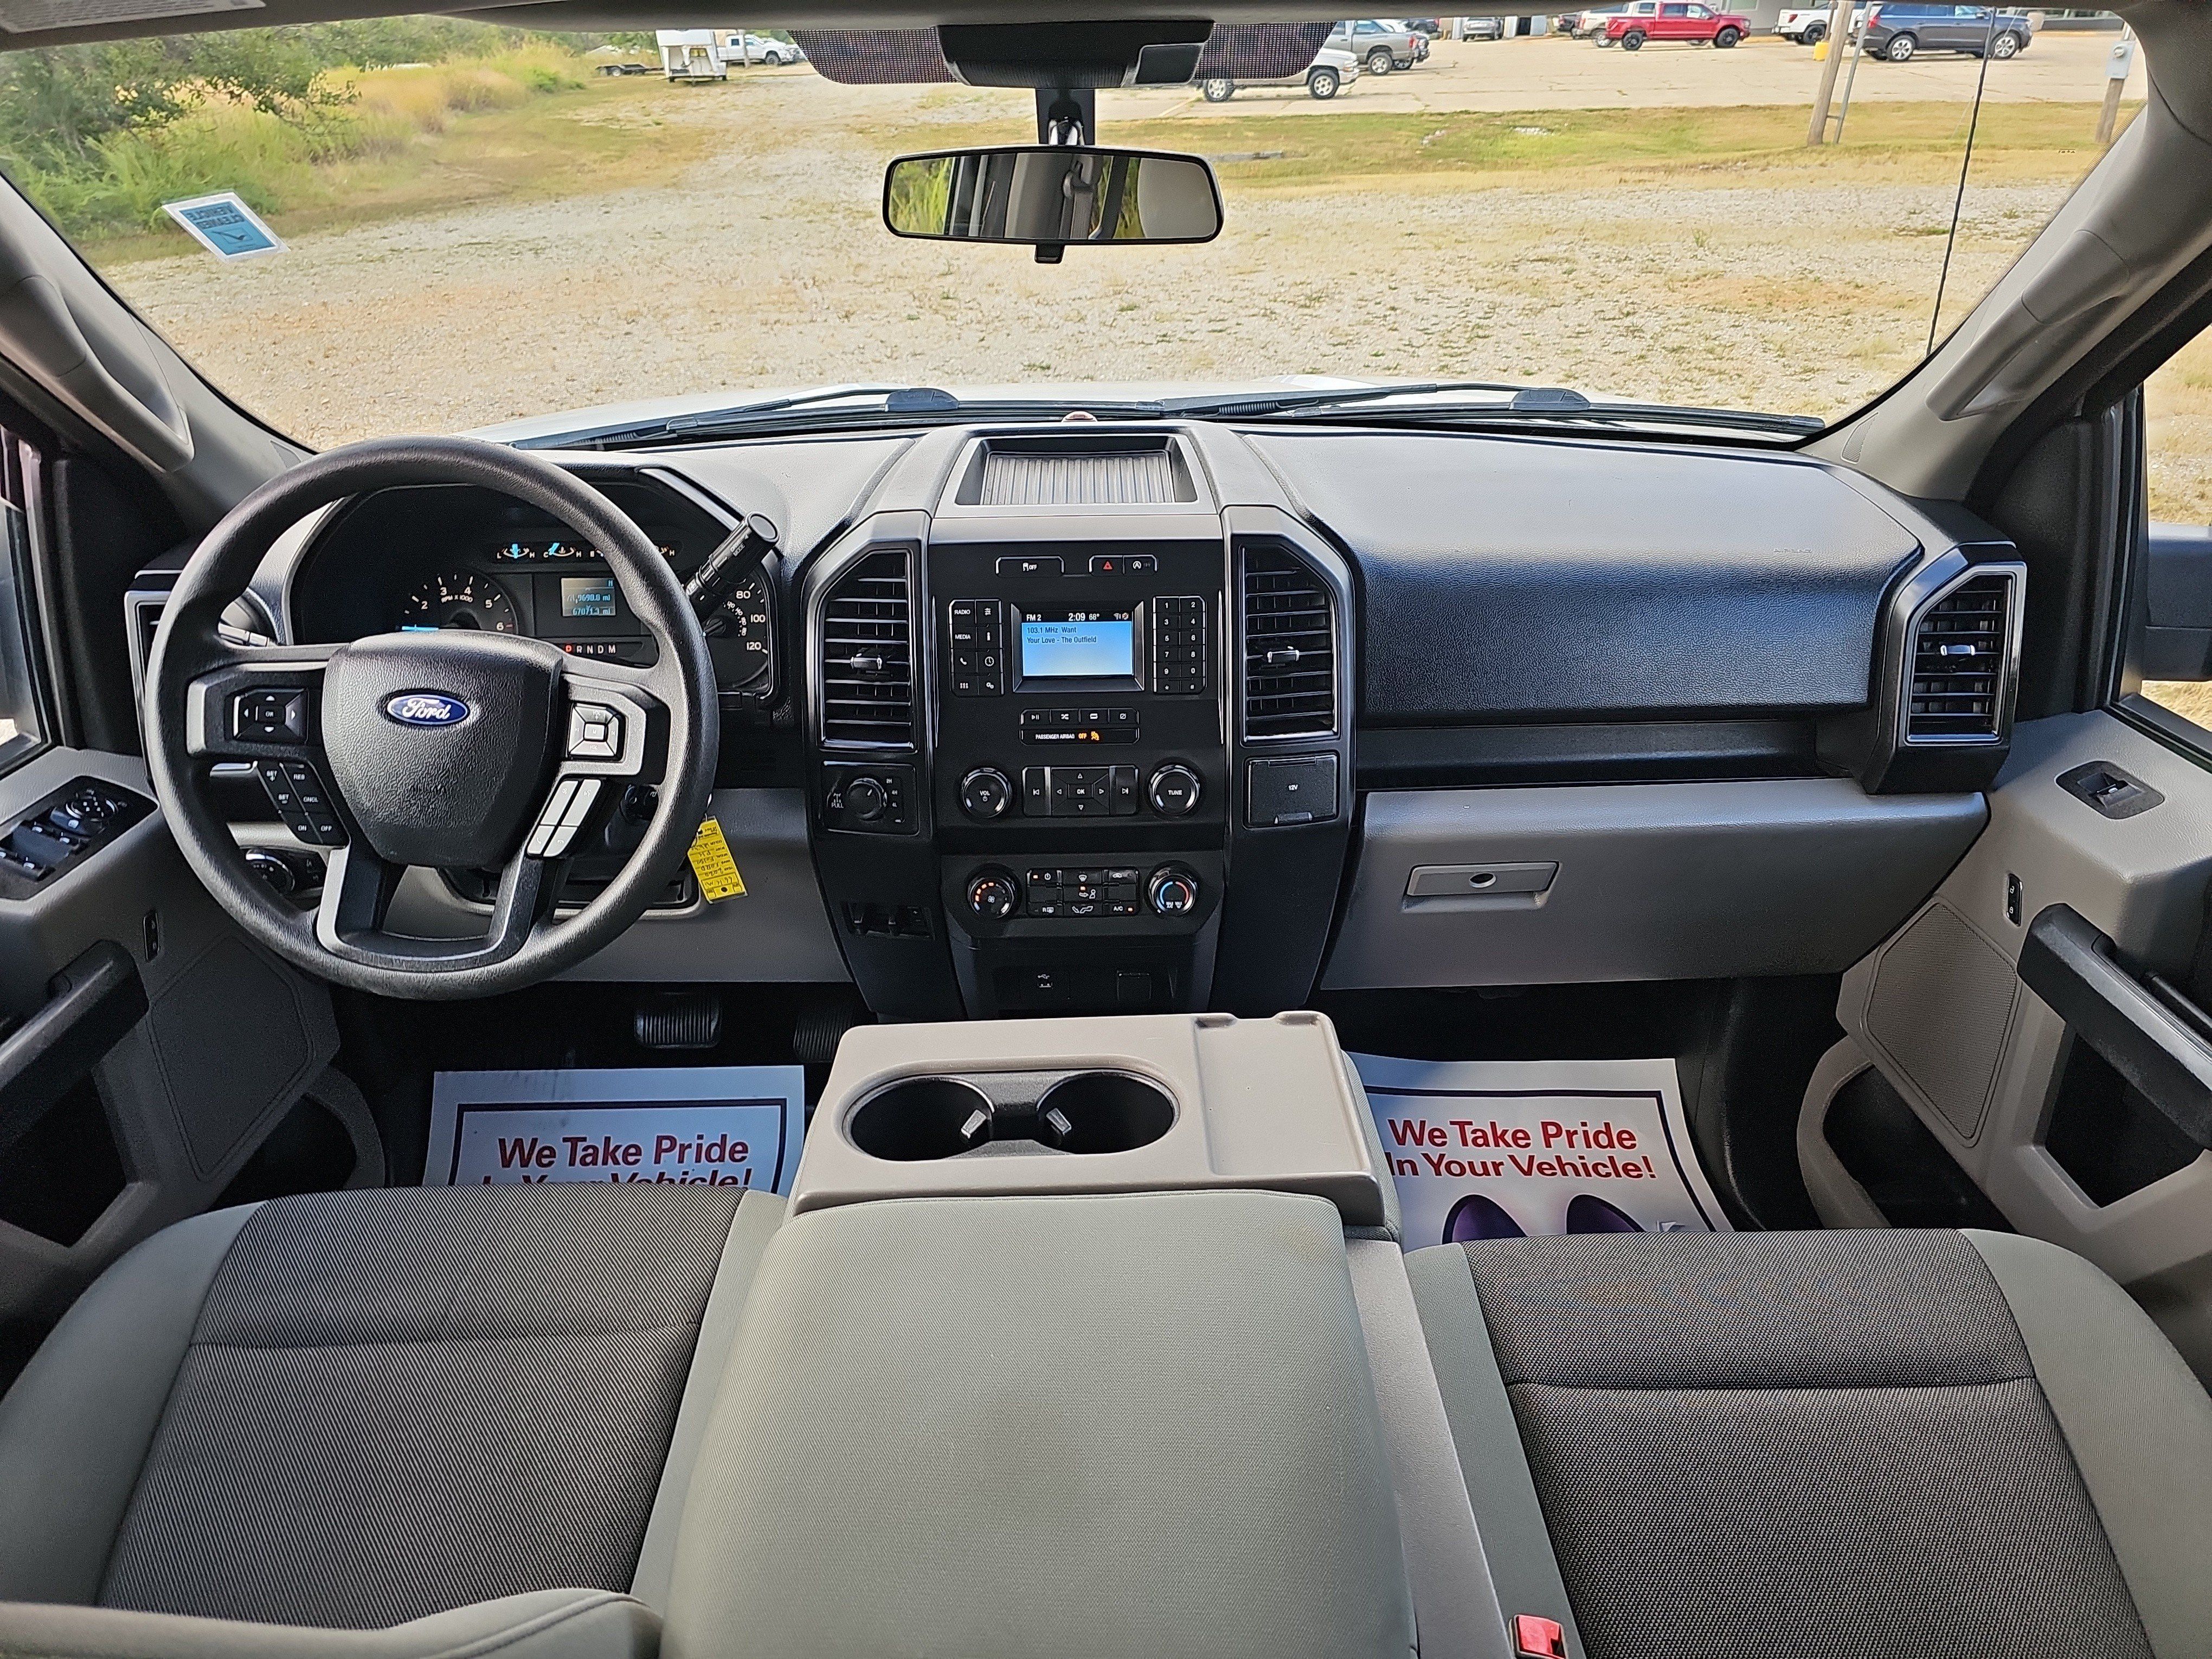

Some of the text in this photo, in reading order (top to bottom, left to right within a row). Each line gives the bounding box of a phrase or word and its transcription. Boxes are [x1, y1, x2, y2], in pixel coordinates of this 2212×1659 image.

[440, 587, 447, 595] 3
[464, 586, 472, 595] 4
[736, 590, 751, 599] 80
[421, 601, 428, 610] 2
[485, 600, 493, 608] 5
[750, 614, 766, 623] 100
[1026, 614, 1037, 622] FM
[1037, 614, 1042, 622] 2
[1068, 613, 1086, 622] 2:09
[496, 622, 504, 631] 6
[577, 645, 582, 653] R
[587, 645, 593, 654] N
[597, 645, 604, 654] D
[608, 645, 616, 654] M
[746, 641, 762, 651] 120
[402, 698, 452, 719] Ford
[1387, 1119, 1637, 1151] We Take Pride
[498, 1133, 749, 1169] We Take Pride
[1384, 1151, 1657, 1179] In Your Vehicle!
